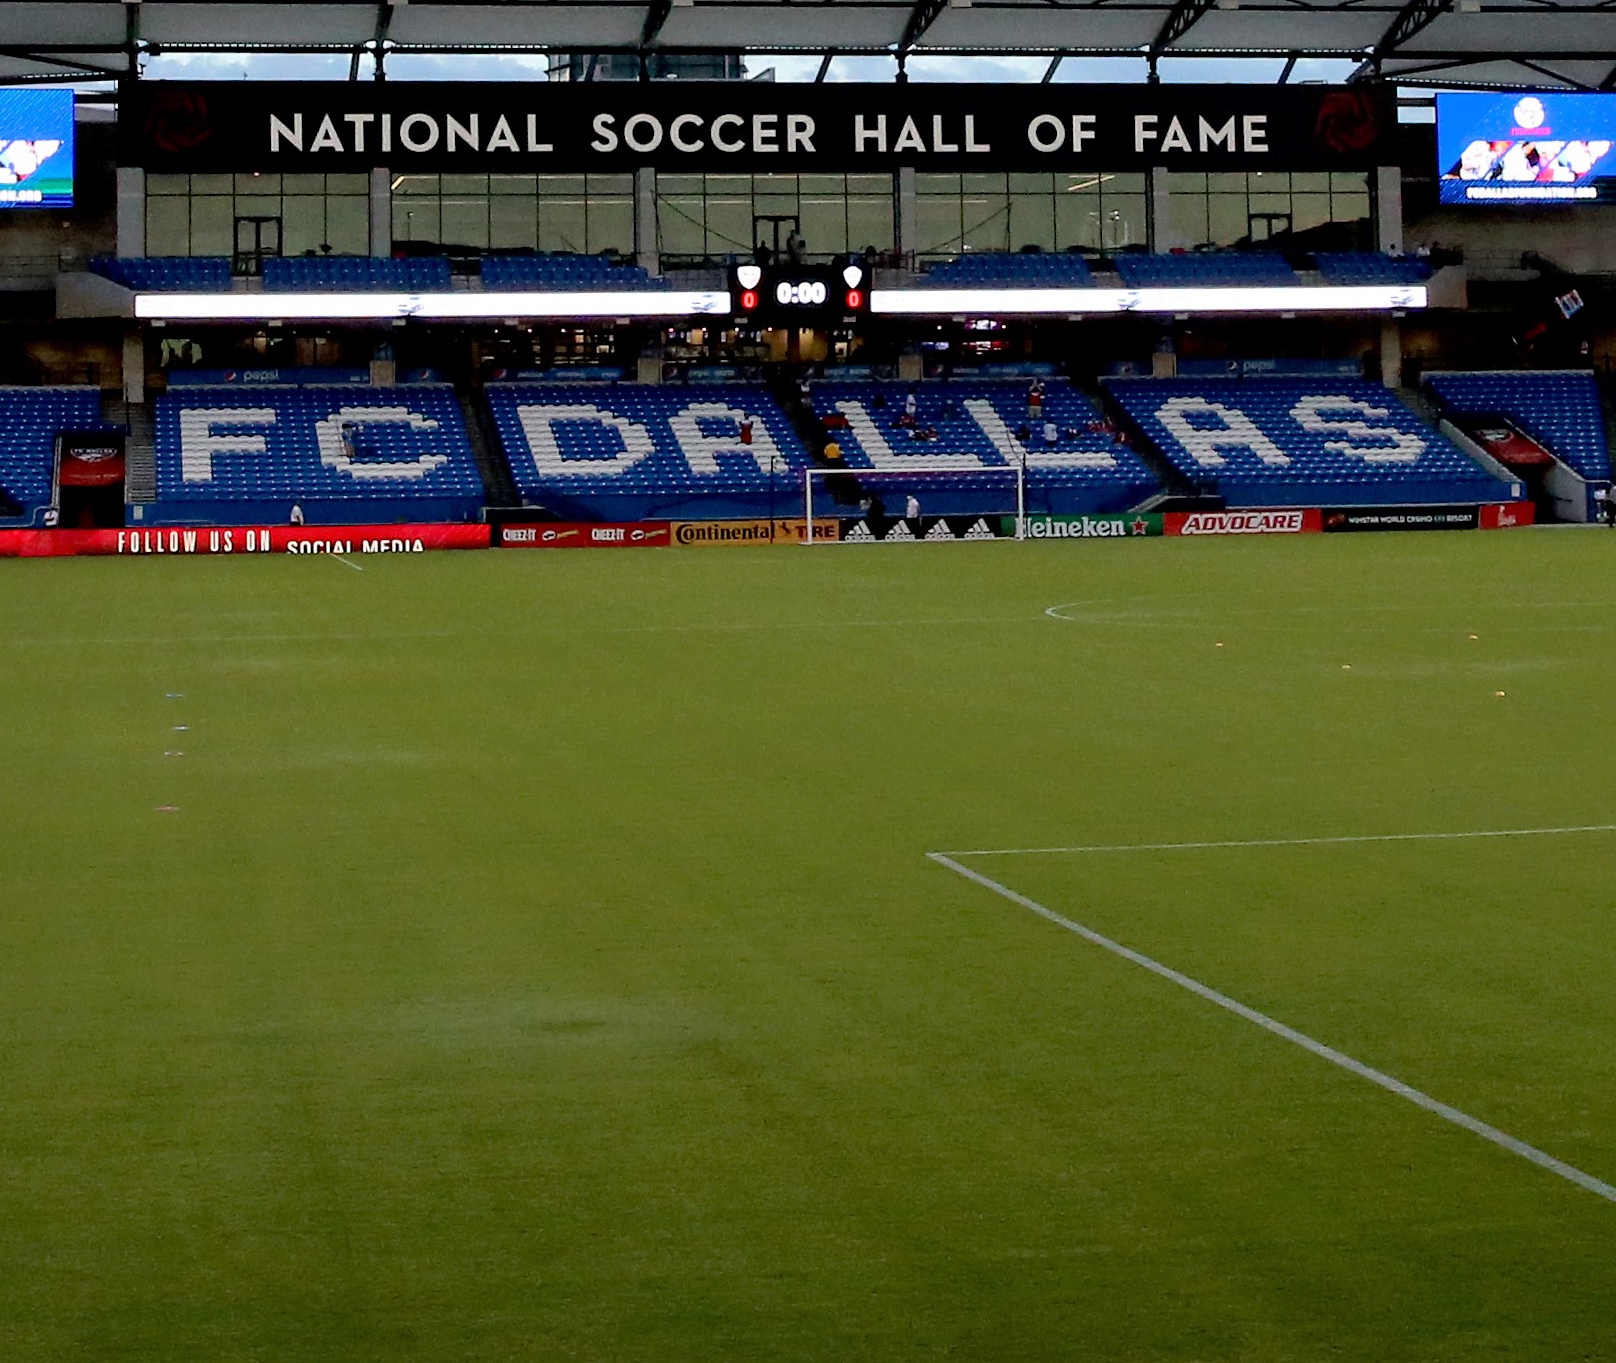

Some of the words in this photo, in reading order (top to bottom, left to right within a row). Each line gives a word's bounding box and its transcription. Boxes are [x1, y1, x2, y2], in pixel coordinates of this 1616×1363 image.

[269, 113, 554, 152] NATIONAL
[590, 113, 816, 153] SOCCER
[854, 114, 991, 152] HALL
[1027, 114, 1096, 153] OF
[1134, 114, 1269, 152] FAME
[743, 291, 756, 309] 0
[776, 281, 827, 305] 0:00
[848, 290, 861, 308] 0
[179, 406, 448, 483] FC
[516, 394, 1427, 478] DALLAS
[675, 522, 775, 544] Continental
[1014, 516, 1126, 539] Heineken
[1181, 510, 1304, 535] ADVOCARE
[117, 530, 196, 553] FOLLOW
[209, 529, 233, 552] US
[246, 529, 270, 551] ON
